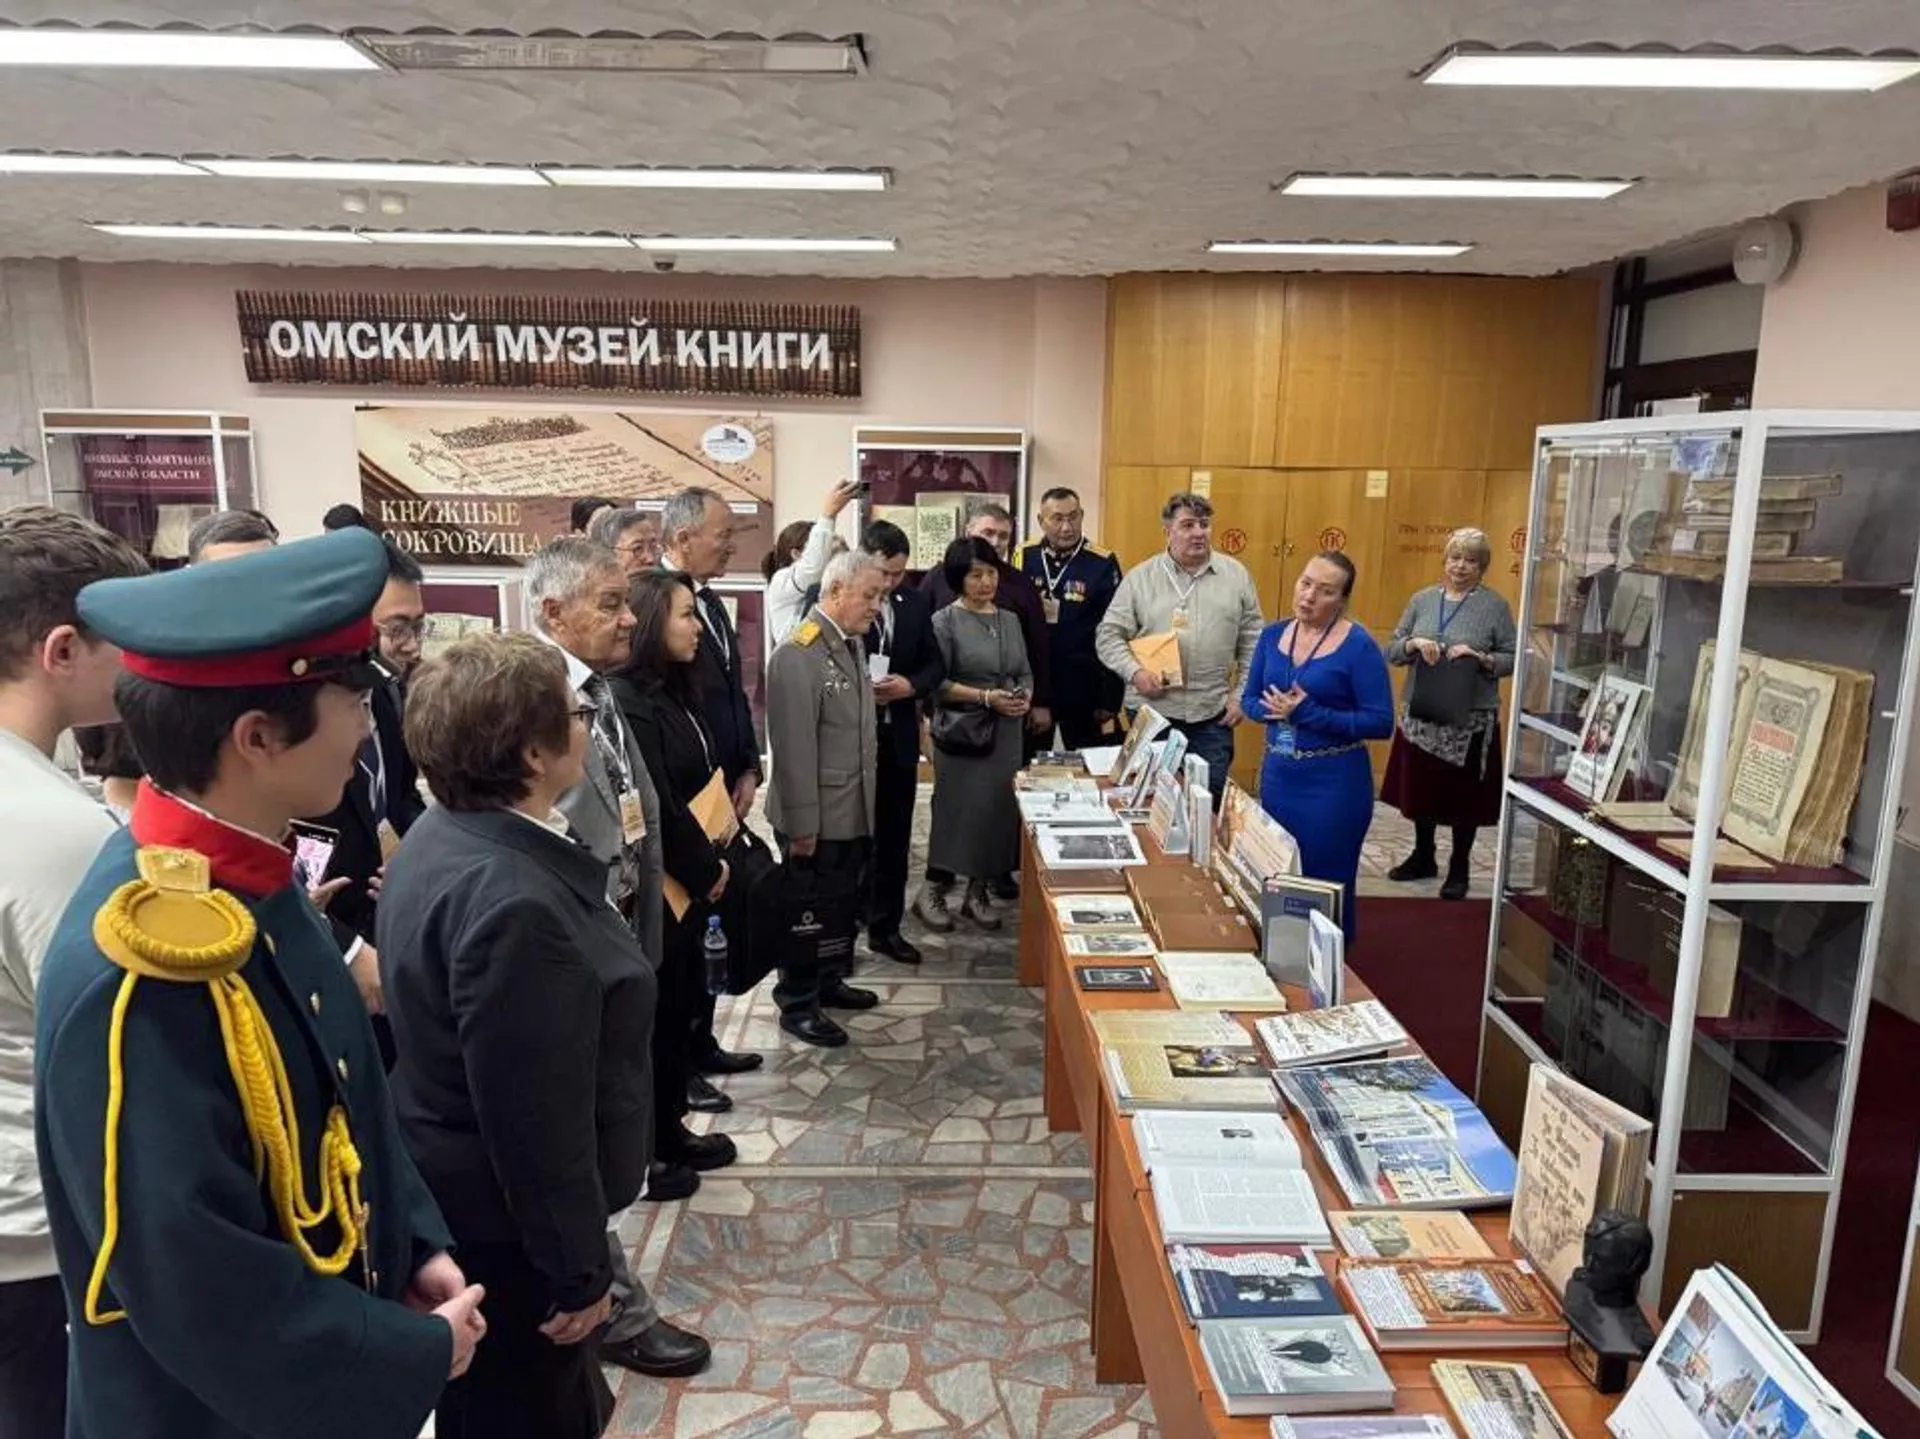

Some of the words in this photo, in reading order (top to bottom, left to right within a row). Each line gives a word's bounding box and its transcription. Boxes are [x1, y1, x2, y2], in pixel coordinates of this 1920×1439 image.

[268, 312, 480, 361] ОМСКИЙ
[494, 316, 661, 366] МУЗЕЙ
[676, 329, 829, 371] КНИГИ
[380, 500, 522, 526] КНИЖНЫЕ
